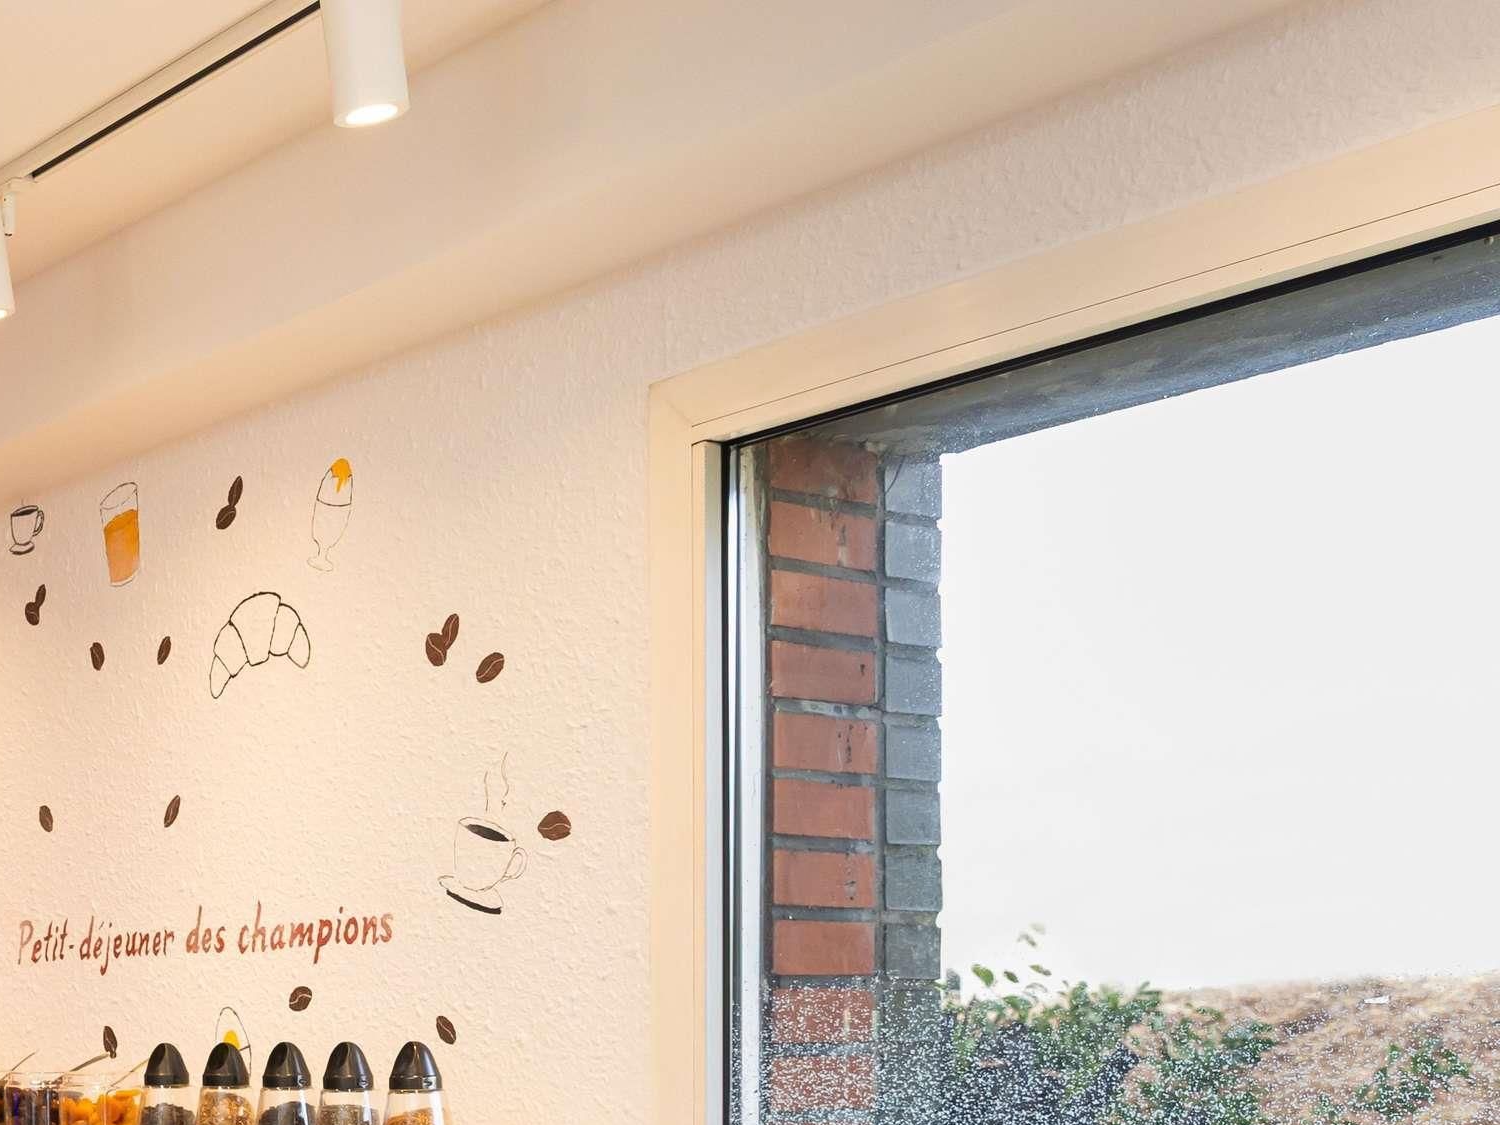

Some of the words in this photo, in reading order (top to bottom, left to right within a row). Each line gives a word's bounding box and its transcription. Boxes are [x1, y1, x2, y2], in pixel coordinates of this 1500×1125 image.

[17, 915, 175, 976] Petit-déjeuner
[185, 904, 226, 955] des
[237, 900, 395, 965] champions
